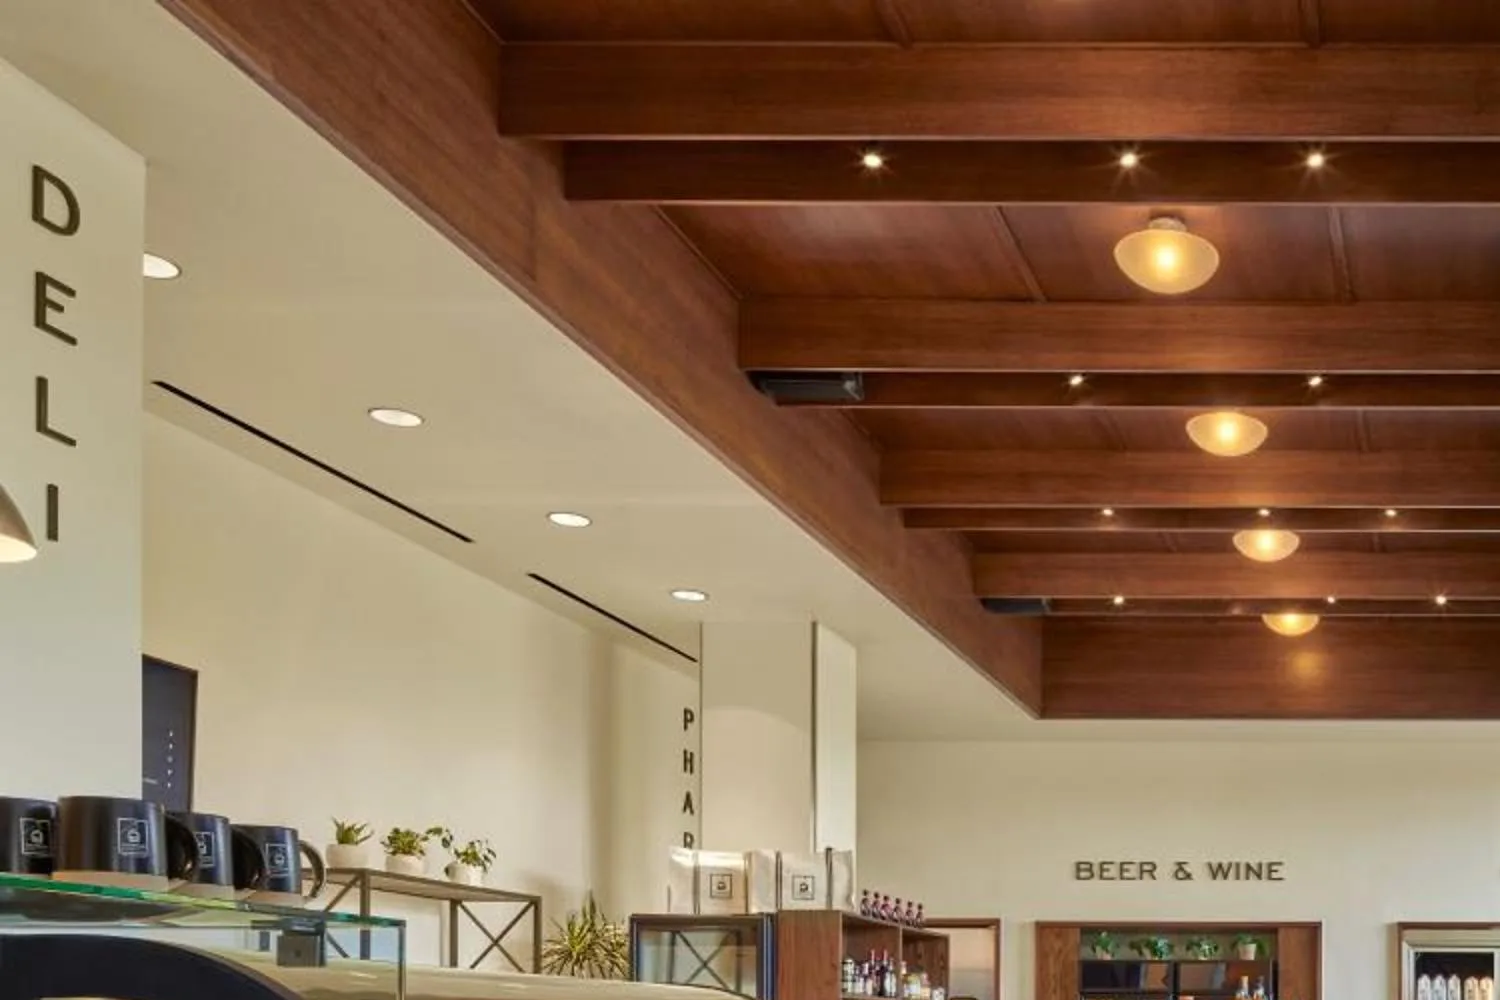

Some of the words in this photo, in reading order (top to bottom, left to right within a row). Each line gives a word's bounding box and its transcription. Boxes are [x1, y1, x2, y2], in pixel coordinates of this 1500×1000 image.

[31, 164, 81, 542] DELI
[1075, 861, 1157, 881] BEER
[1174, 861, 1193, 881] &
[1207, 861, 1285, 881] WINE
